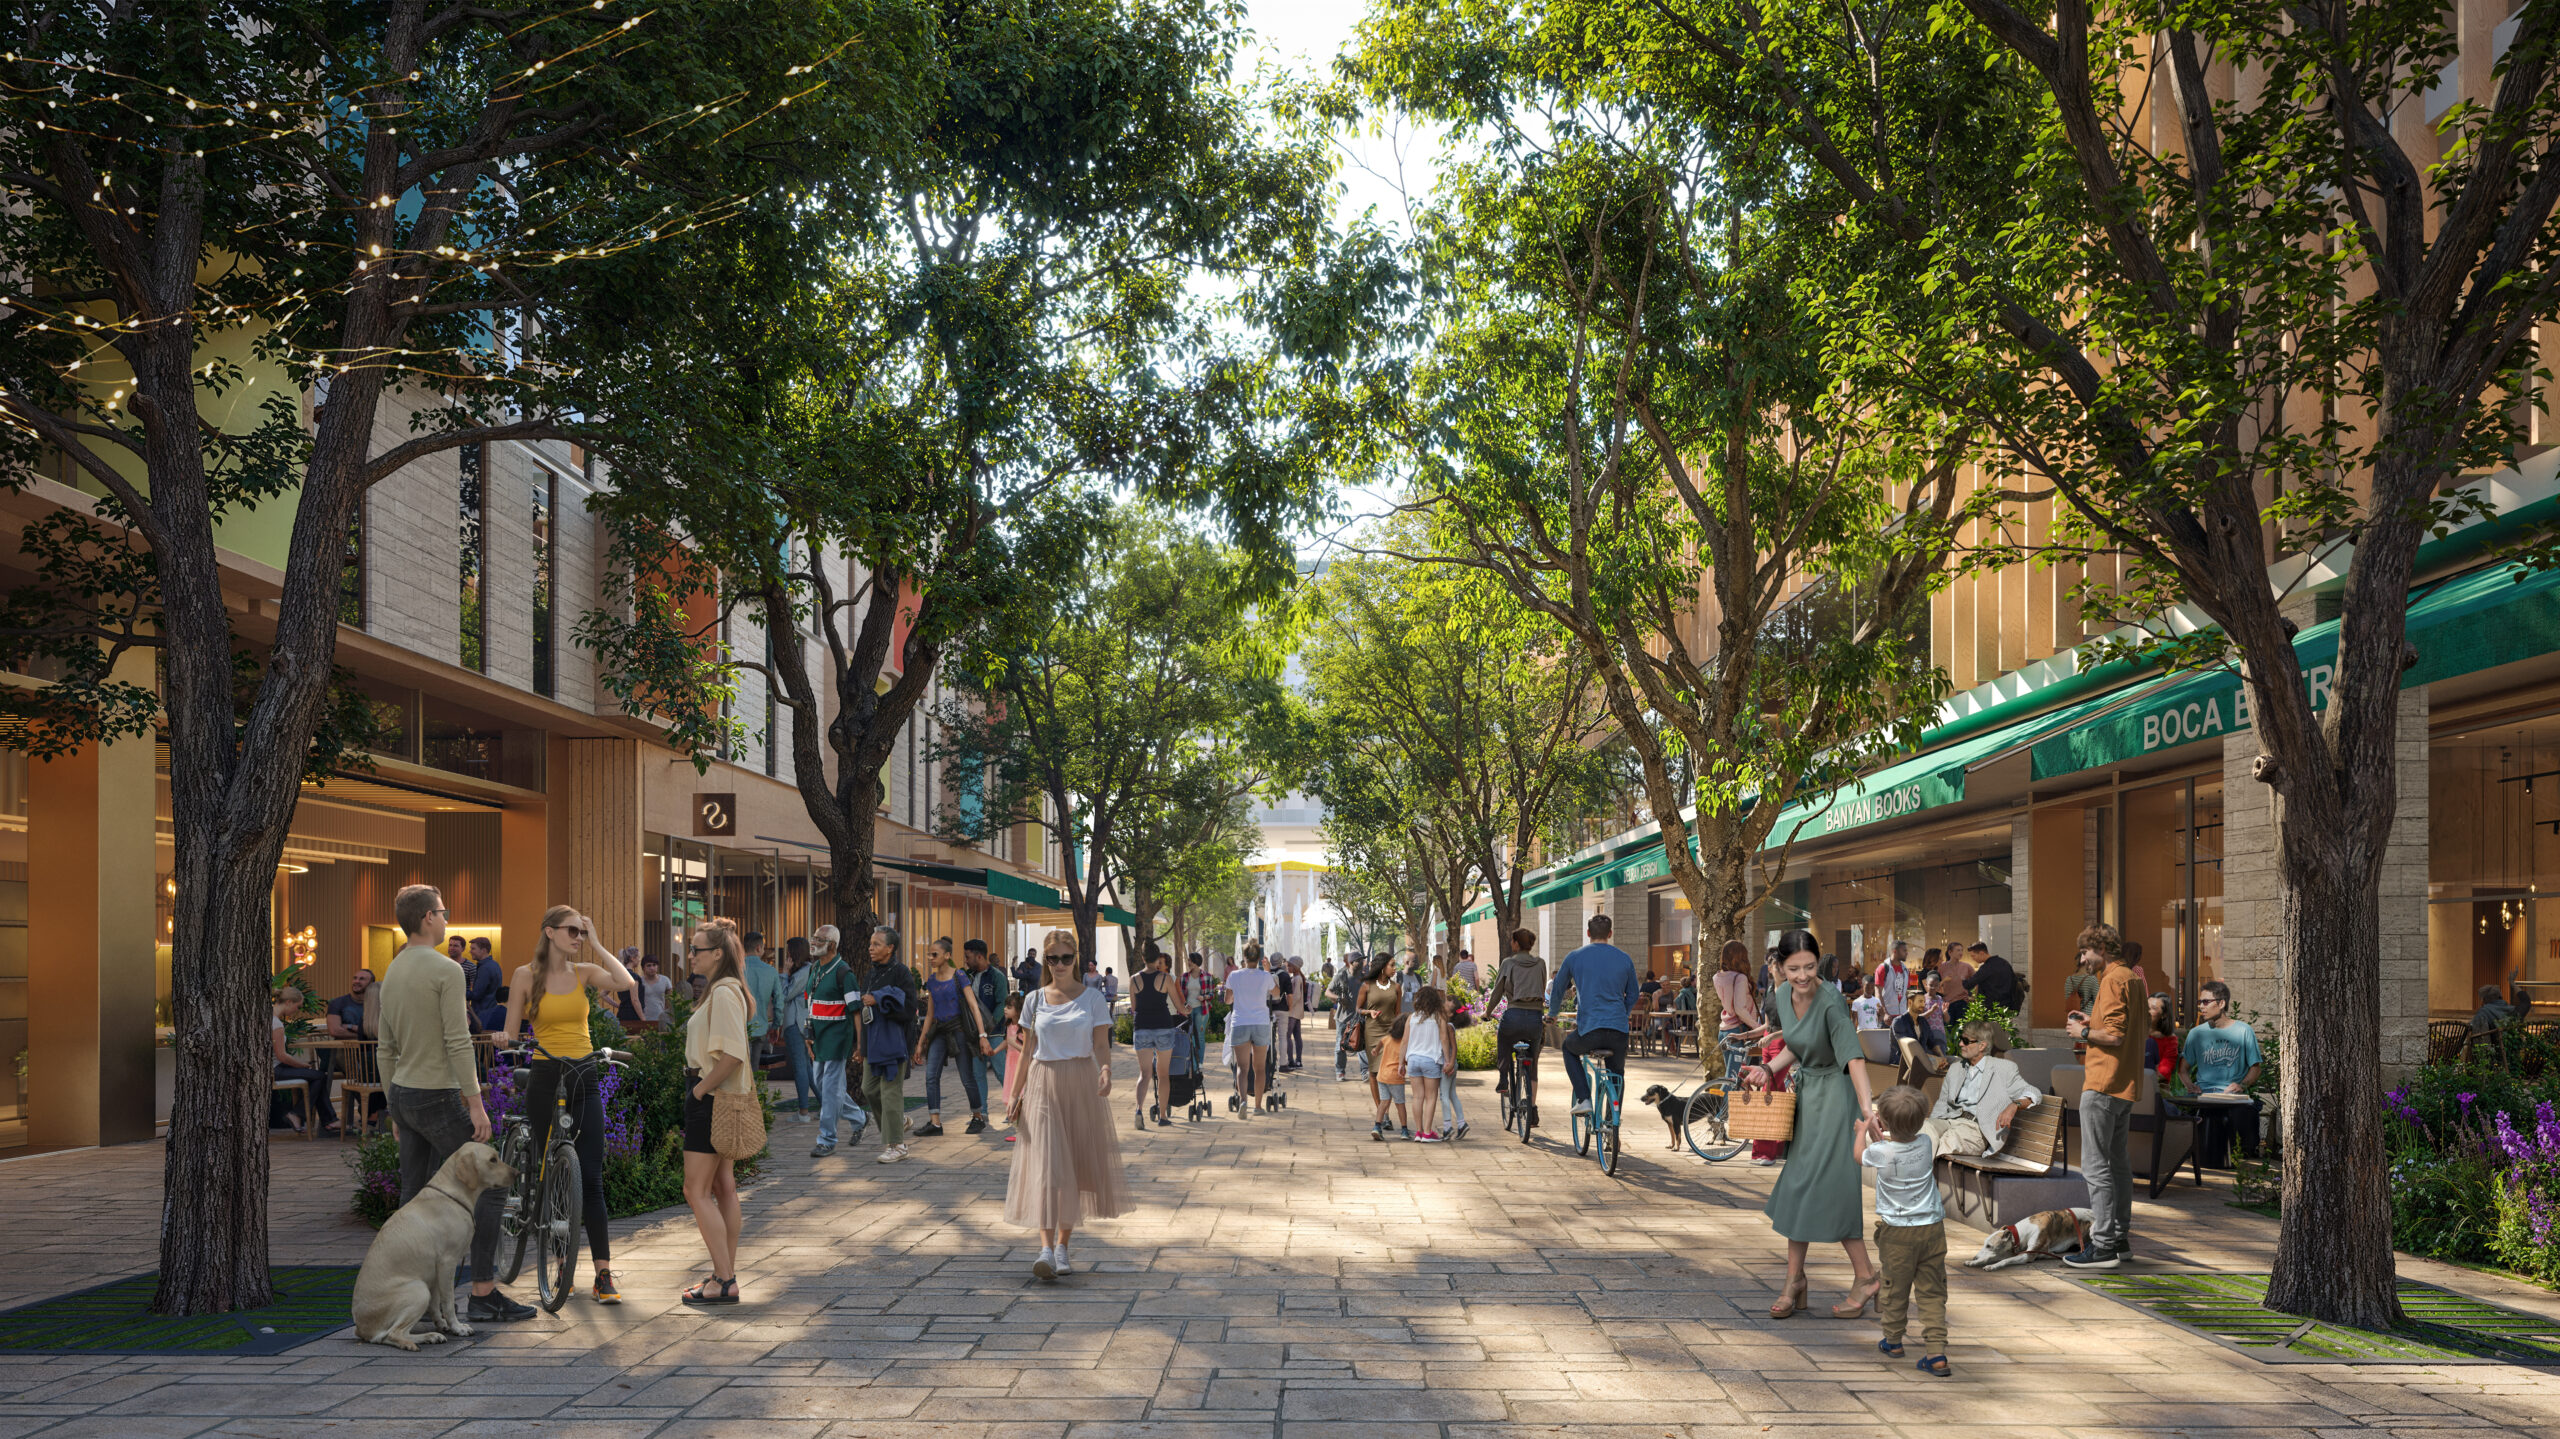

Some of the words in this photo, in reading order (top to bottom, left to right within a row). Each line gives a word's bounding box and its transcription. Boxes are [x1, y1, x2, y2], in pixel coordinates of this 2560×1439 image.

[2143, 698, 2223, 750] BOCA
[1826, 799, 1871, 831] BANYAN
[1875, 784, 1921, 819] BOOKS
[1640, 860, 1658, 879] DESIGN
